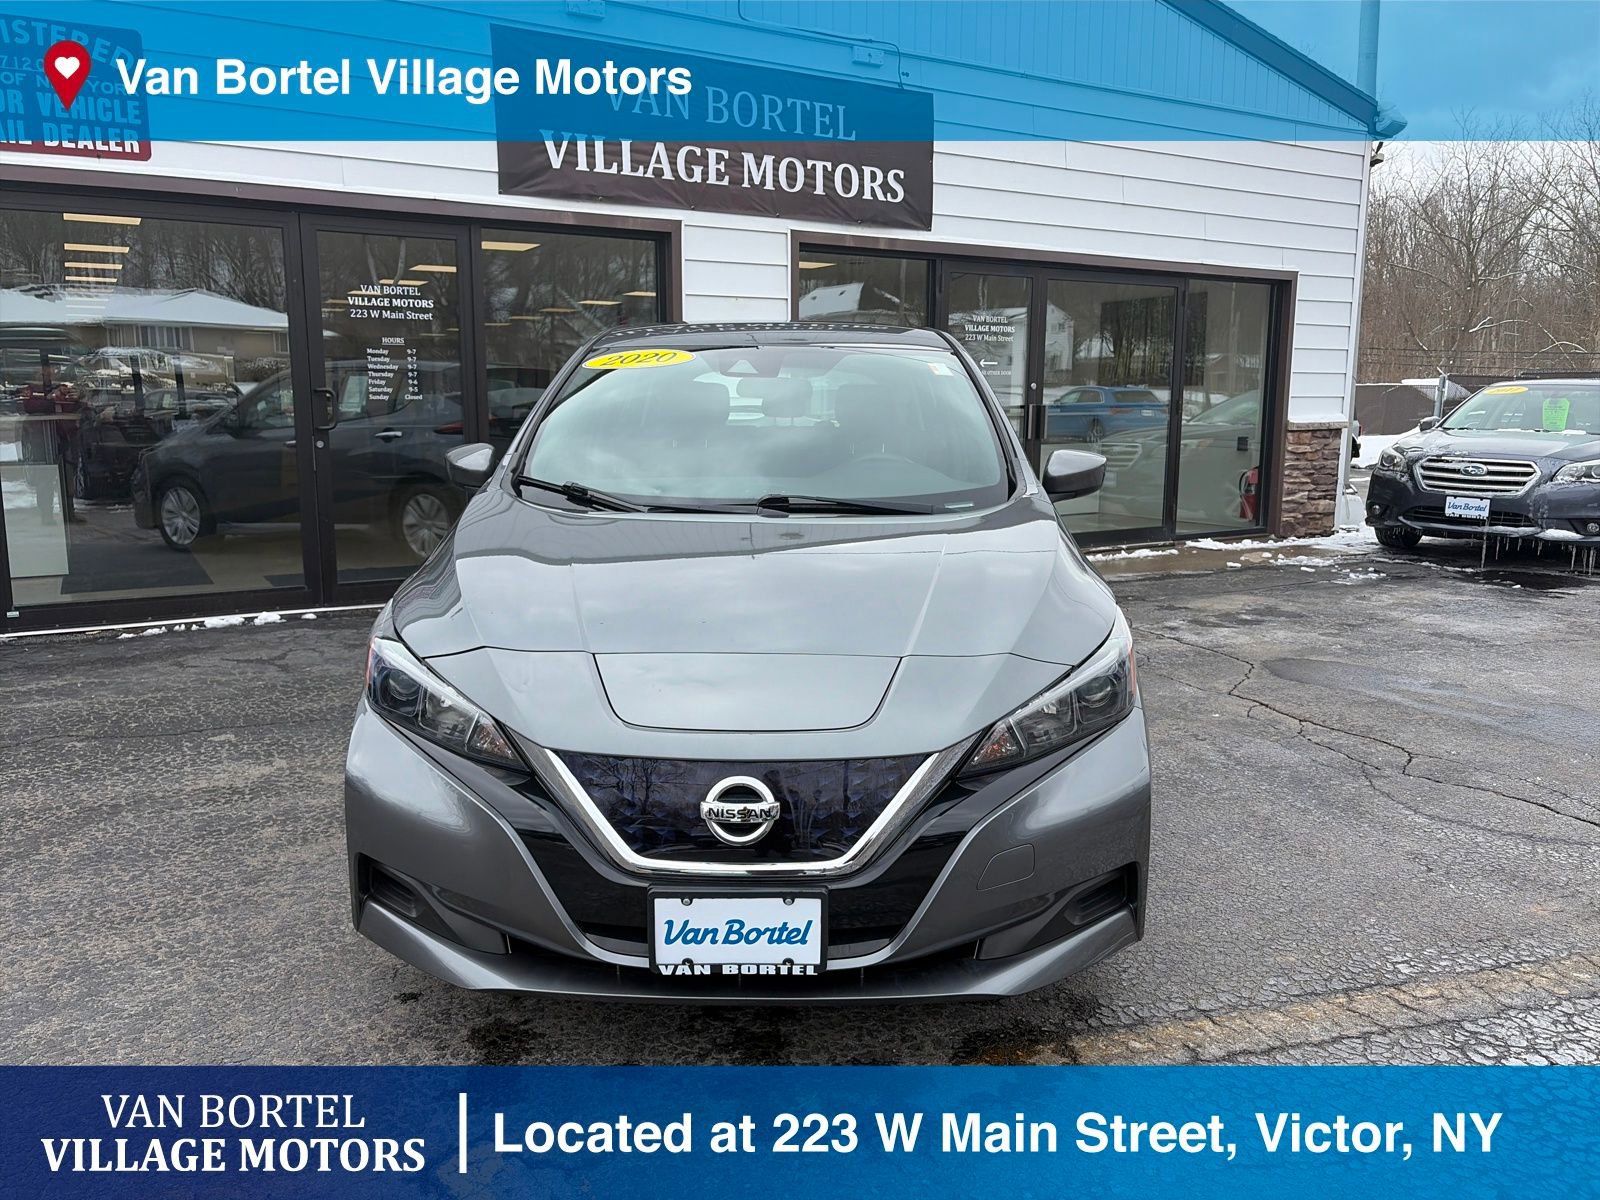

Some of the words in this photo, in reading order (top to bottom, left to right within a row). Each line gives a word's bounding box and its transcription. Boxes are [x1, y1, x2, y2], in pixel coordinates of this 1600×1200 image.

[86, 79, 140, 97] YOR
[706, 86, 856, 141] BORTEL
[42, 122, 140, 153] DEALER
[539, 129, 730, 186] VILLAGE
[741, 152, 906, 203] MOTORS
[360, 285, 380, 294] VAN
[383, 286, 421, 296] BORTEL
[347, 297, 390, 306] VILLAGE
[392, 299, 434, 308] MOTORS
[350, 309, 368, 318] 223
[370, 310, 380, 318] W
[382, 311, 404, 319] Main
[406, 312, 433, 320] Street
[964, 324, 989, 332] VILLAGE
[990, 325, 1015, 333] MOTORS
[965, 333, 976, 341] 223
[367, 355, 390, 363] Tuesday
[600, 352, 677, 366] 2020
[367, 363, 399, 371] Wednesday
[1448, 502, 1462, 510] Van
[1462, 503, 1487, 511] Bortel
[708, 807, 771, 819] NISSAN
[664, 919, 719, 945] Van
[721, 919, 813, 945] Bortel
[658, 964, 711, 975] VAN
[722, 964, 818, 976] BORTEL
